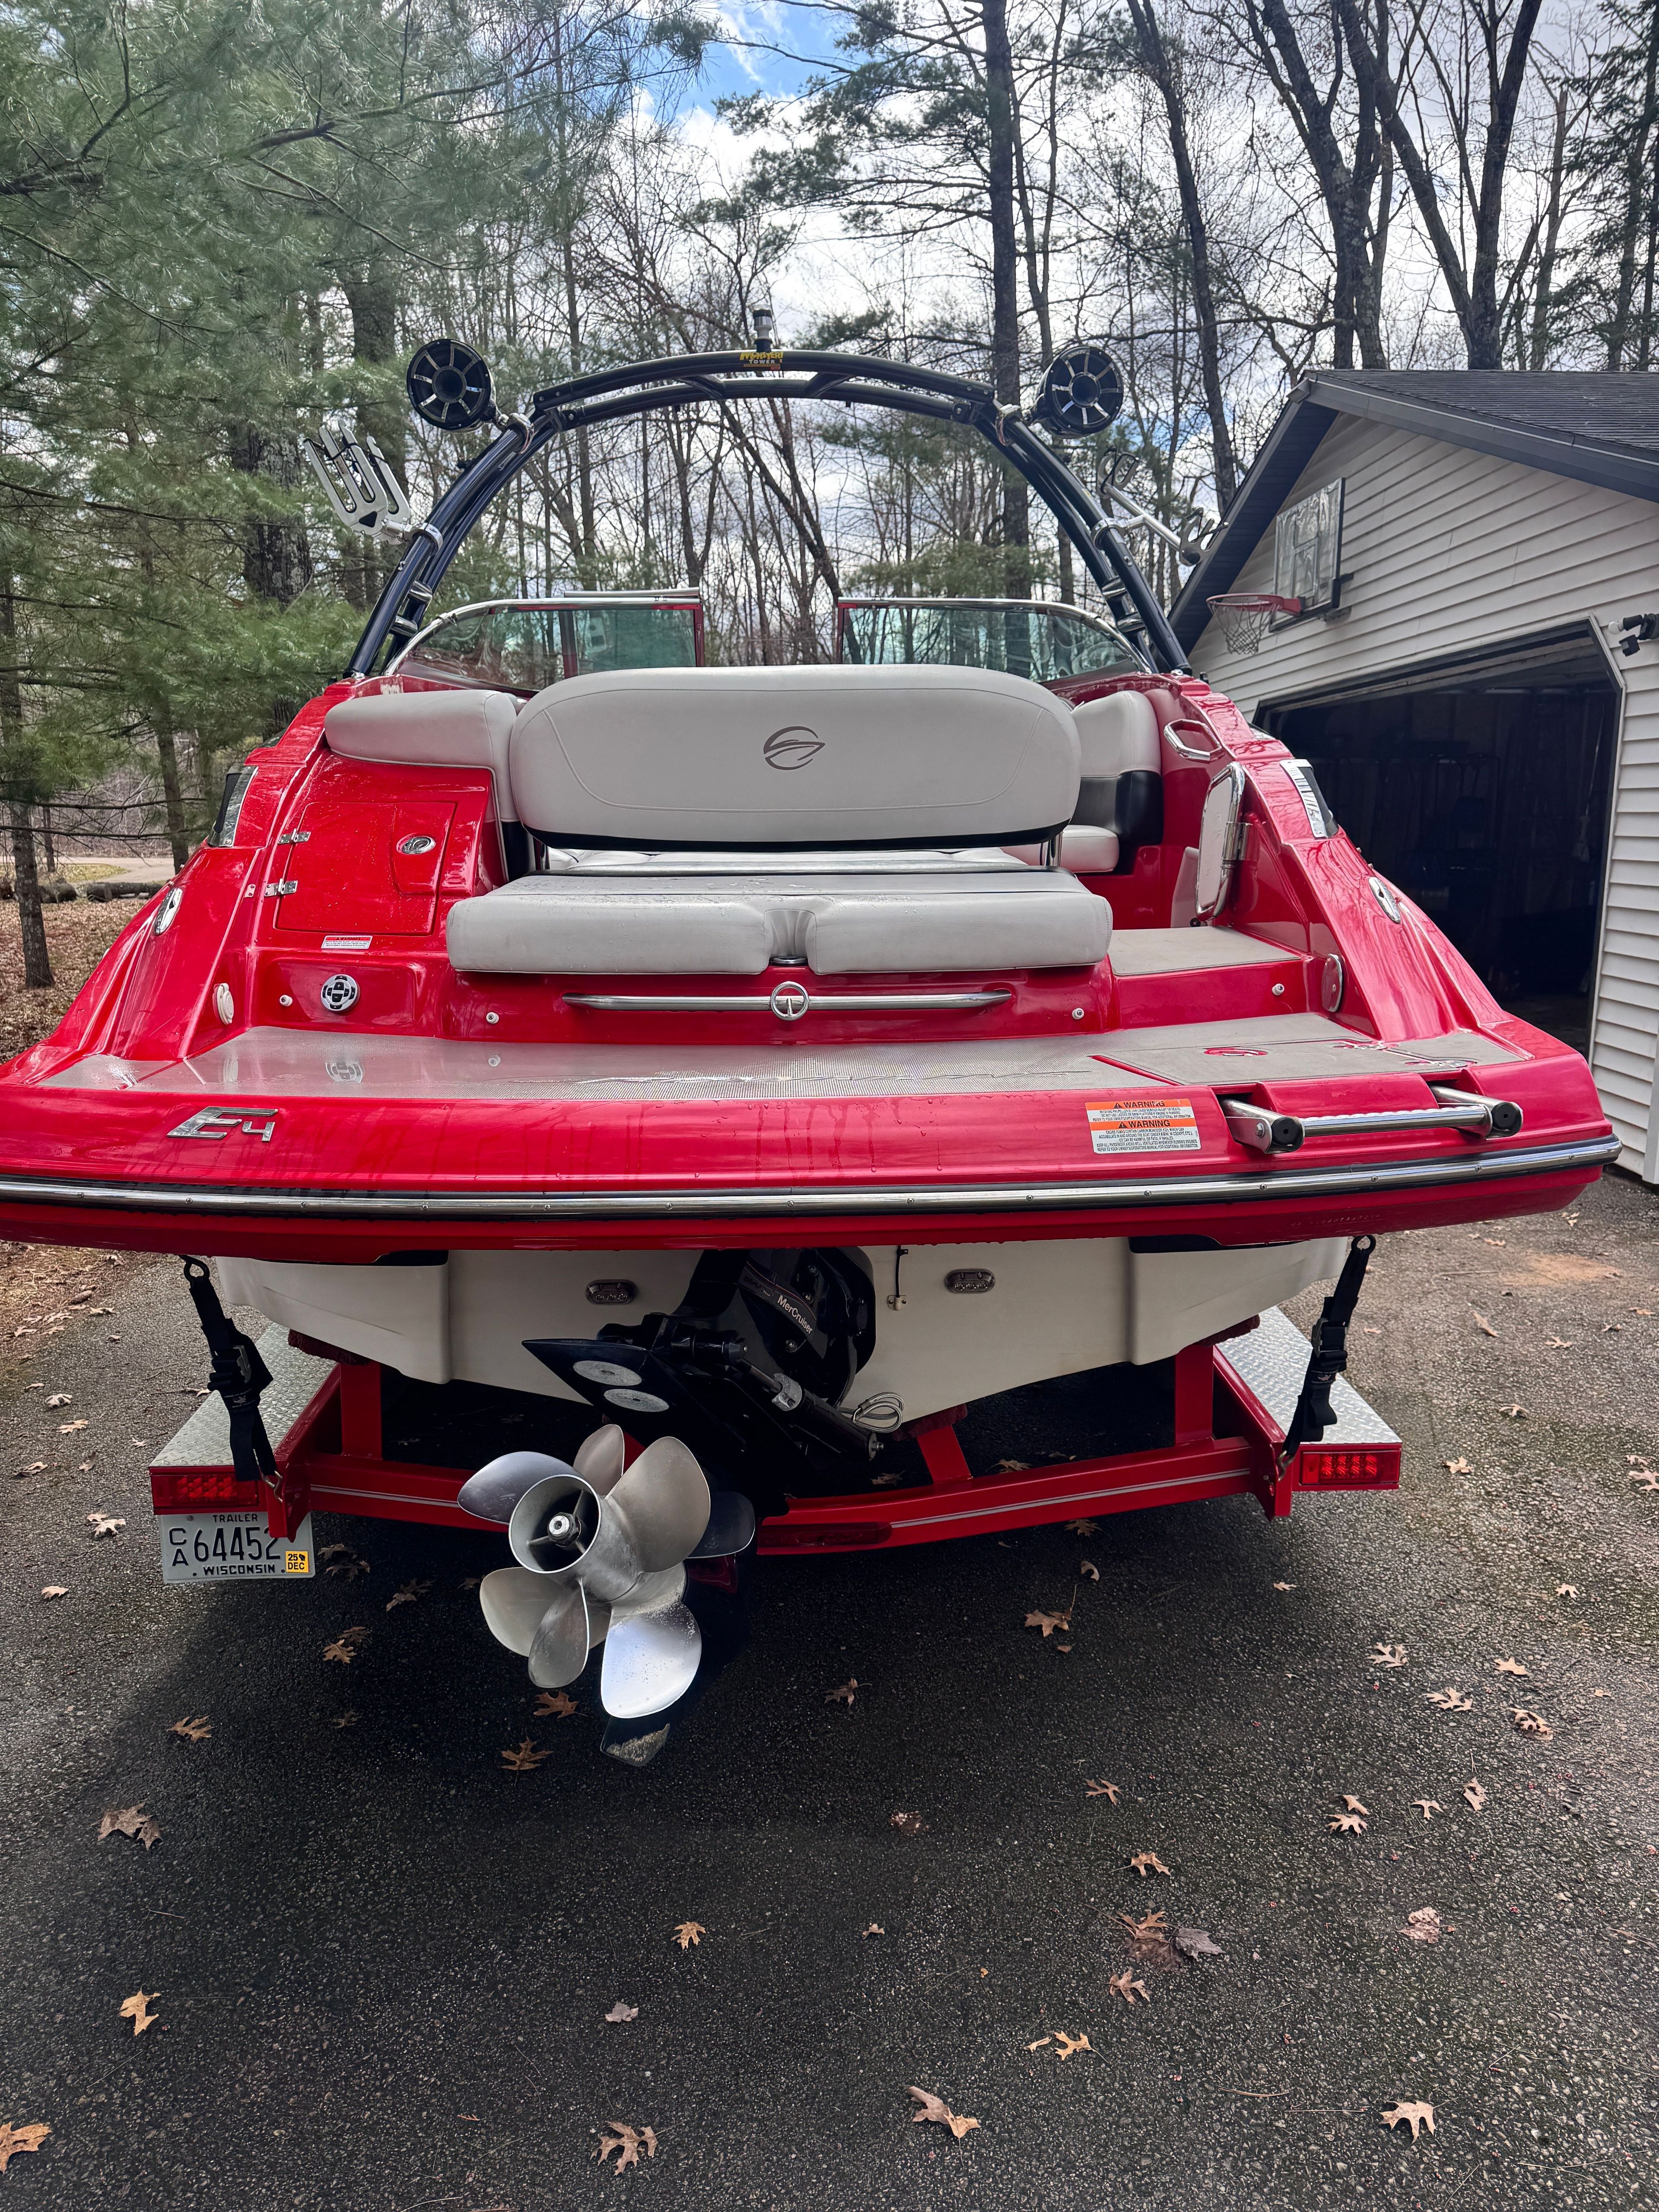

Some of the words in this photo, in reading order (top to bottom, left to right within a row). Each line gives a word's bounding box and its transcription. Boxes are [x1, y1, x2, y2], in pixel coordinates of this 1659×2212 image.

[166, 1106, 279, 1141] E4
[1128, 1120, 1170, 1128] WARNING
[777, 1295, 813, 1334] MerCruiser
[213, 1513, 258, 1522] TRAILER
[194, 1526, 281, 1562] 64452
[203, 1564, 275, 1575] WISCONSIN
